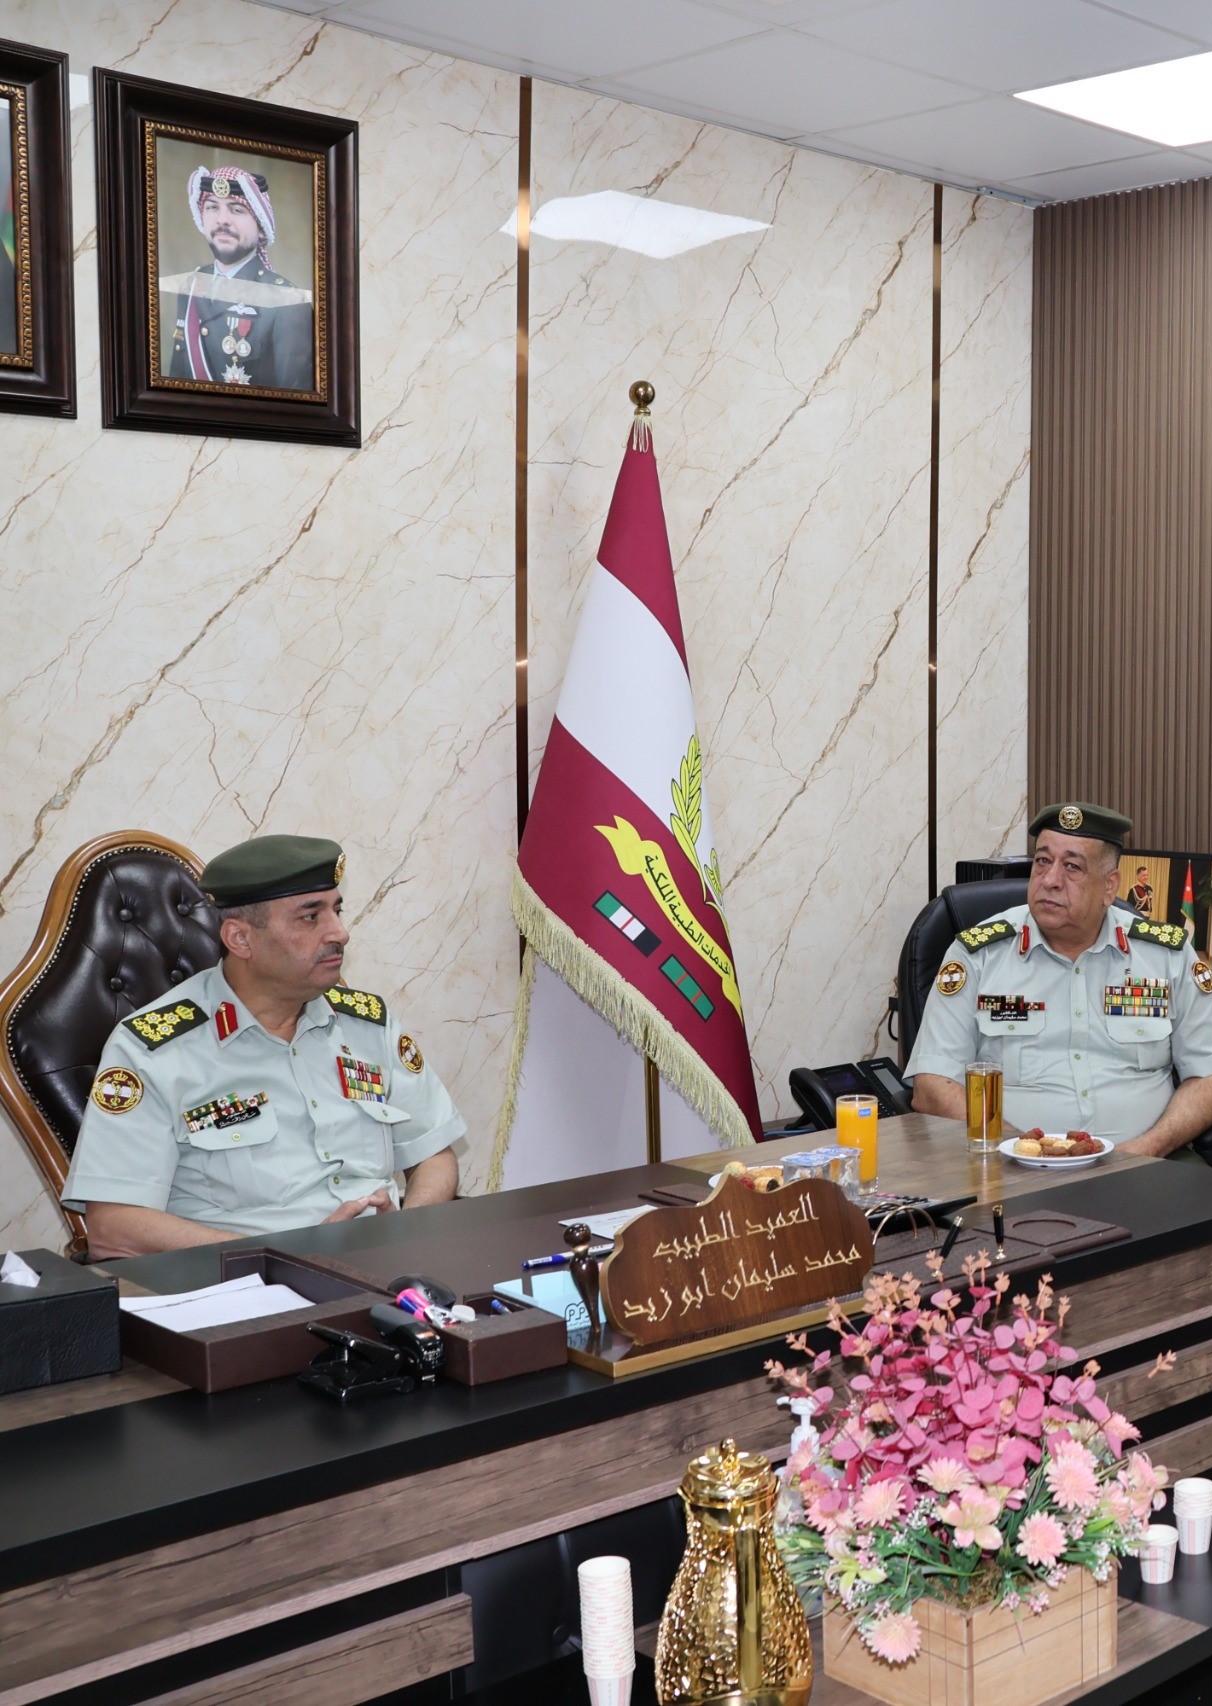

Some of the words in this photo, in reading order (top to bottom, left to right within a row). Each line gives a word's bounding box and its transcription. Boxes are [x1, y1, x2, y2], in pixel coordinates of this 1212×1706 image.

[644, 855, 677, 904] الملكية
[669, 902, 704, 946] الطبية
[652, 1209, 741, 1263] الطبيب
[745, 1192, 820, 1240] العميد
[721, 1250, 798, 1301] سليمان
[804, 1243, 862, 1272] محمد
